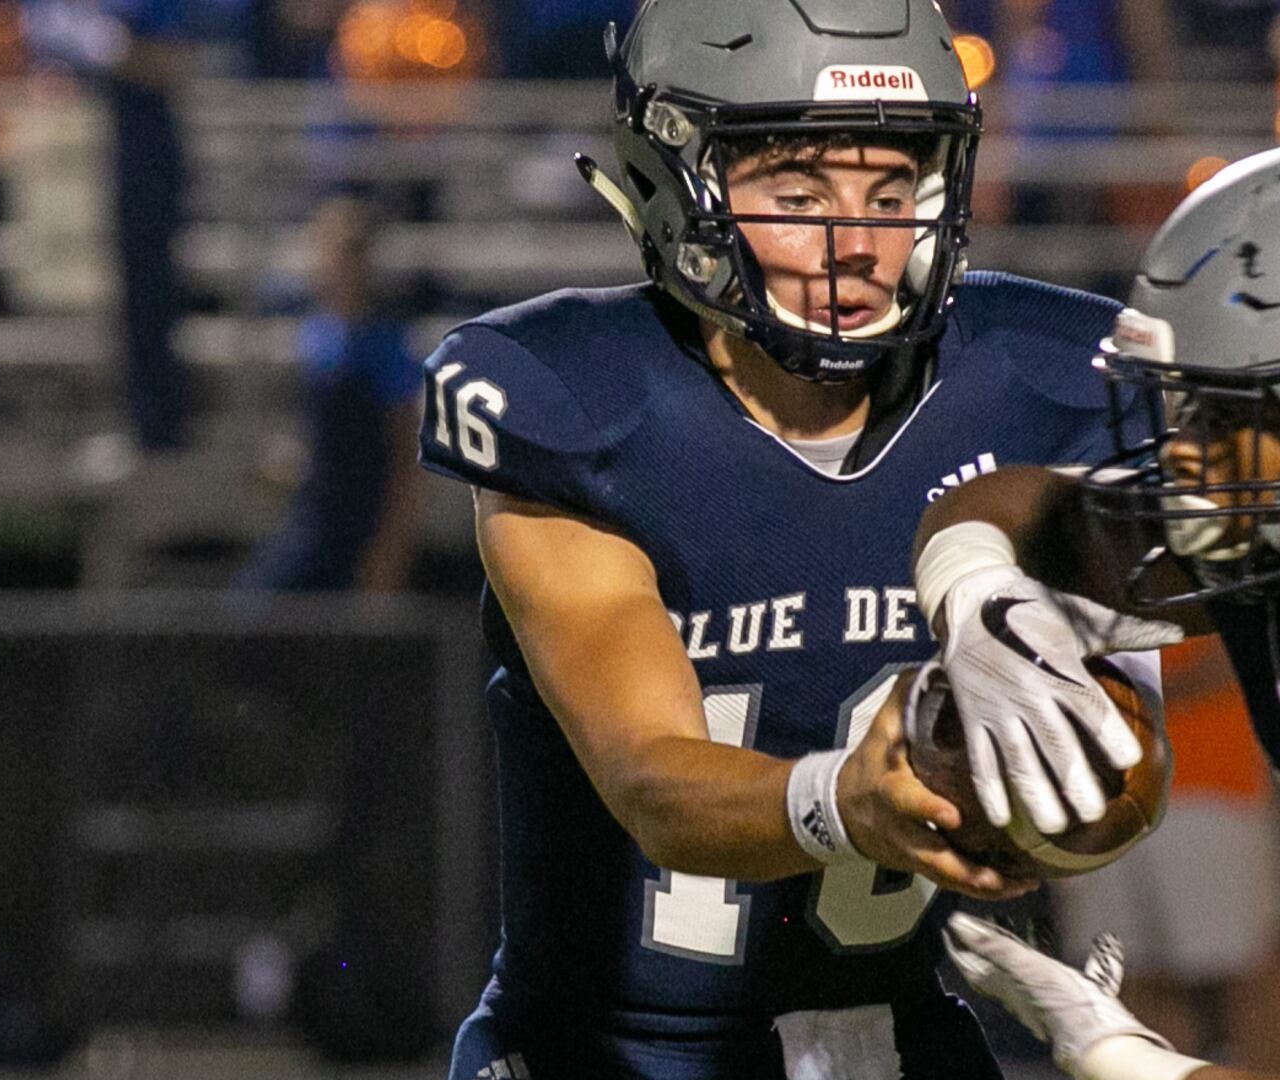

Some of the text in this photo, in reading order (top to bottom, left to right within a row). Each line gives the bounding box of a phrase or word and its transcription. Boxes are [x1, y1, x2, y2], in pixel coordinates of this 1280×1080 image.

[829, 70, 914, 90] Riddell
[820, 358, 864, 370] Riddell
[434, 362, 507, 470] 16
[669, 587, 933, 659] LUE DE
